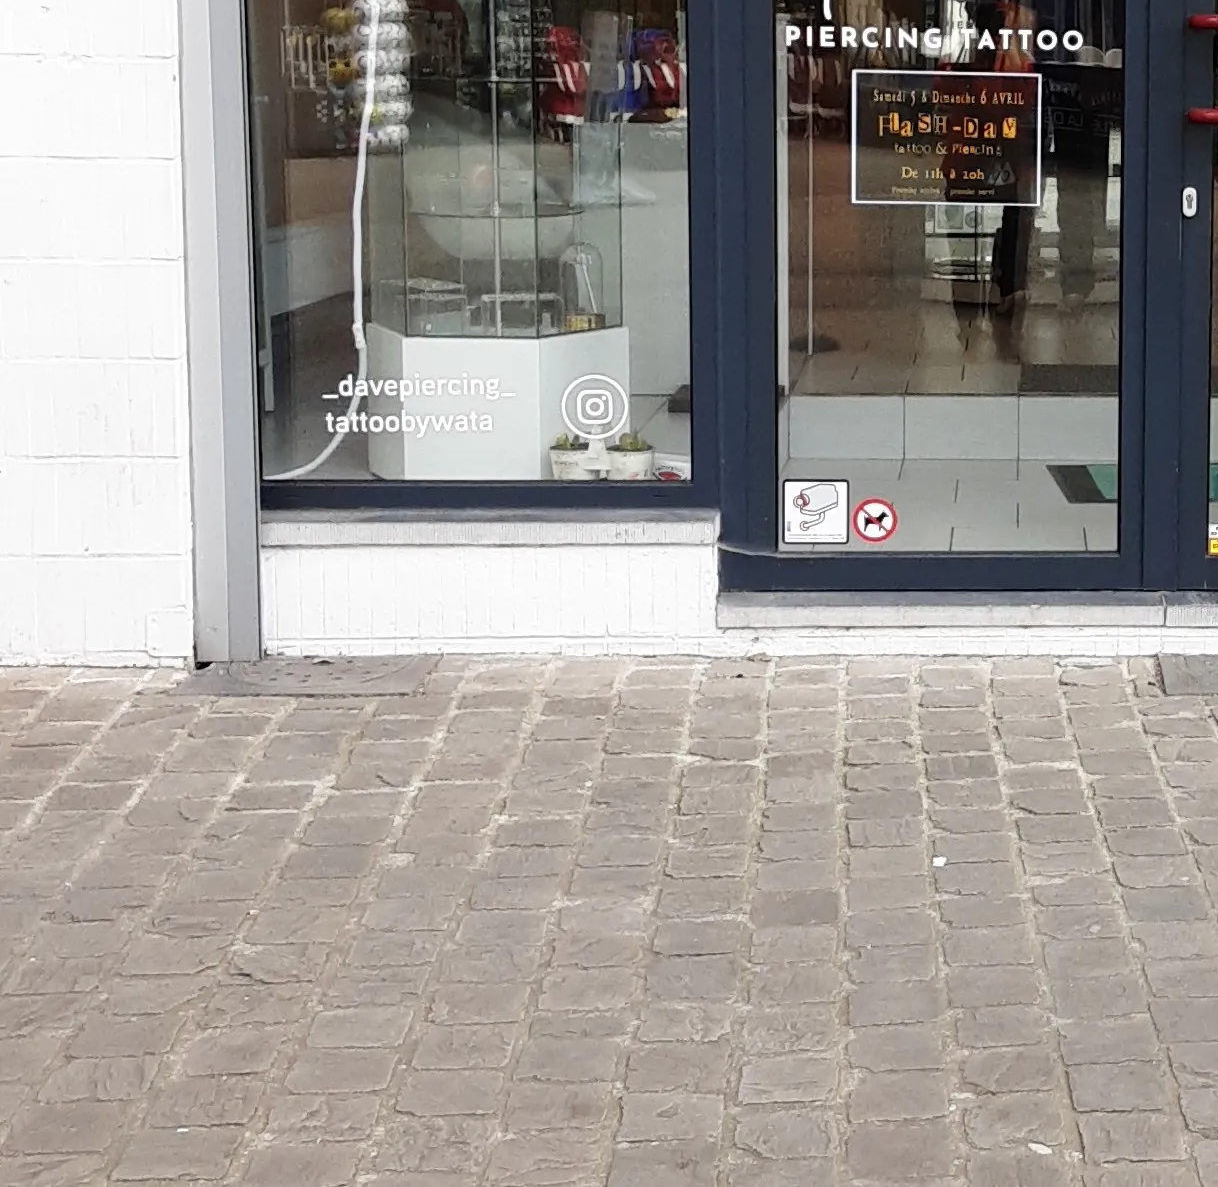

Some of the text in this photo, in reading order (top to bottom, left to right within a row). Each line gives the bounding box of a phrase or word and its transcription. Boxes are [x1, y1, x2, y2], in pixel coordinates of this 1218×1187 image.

[785, 25, 1084, 51] PIERCING TATTOO
[931, 90, 976, 105] Dimanche
[992, 91, 1025, 105] AVRIL
[901, 166, 918, 179] De
[322, 373, 517, 401] _davepiercing_
[325, 411, 493, 439] tattoobywata
